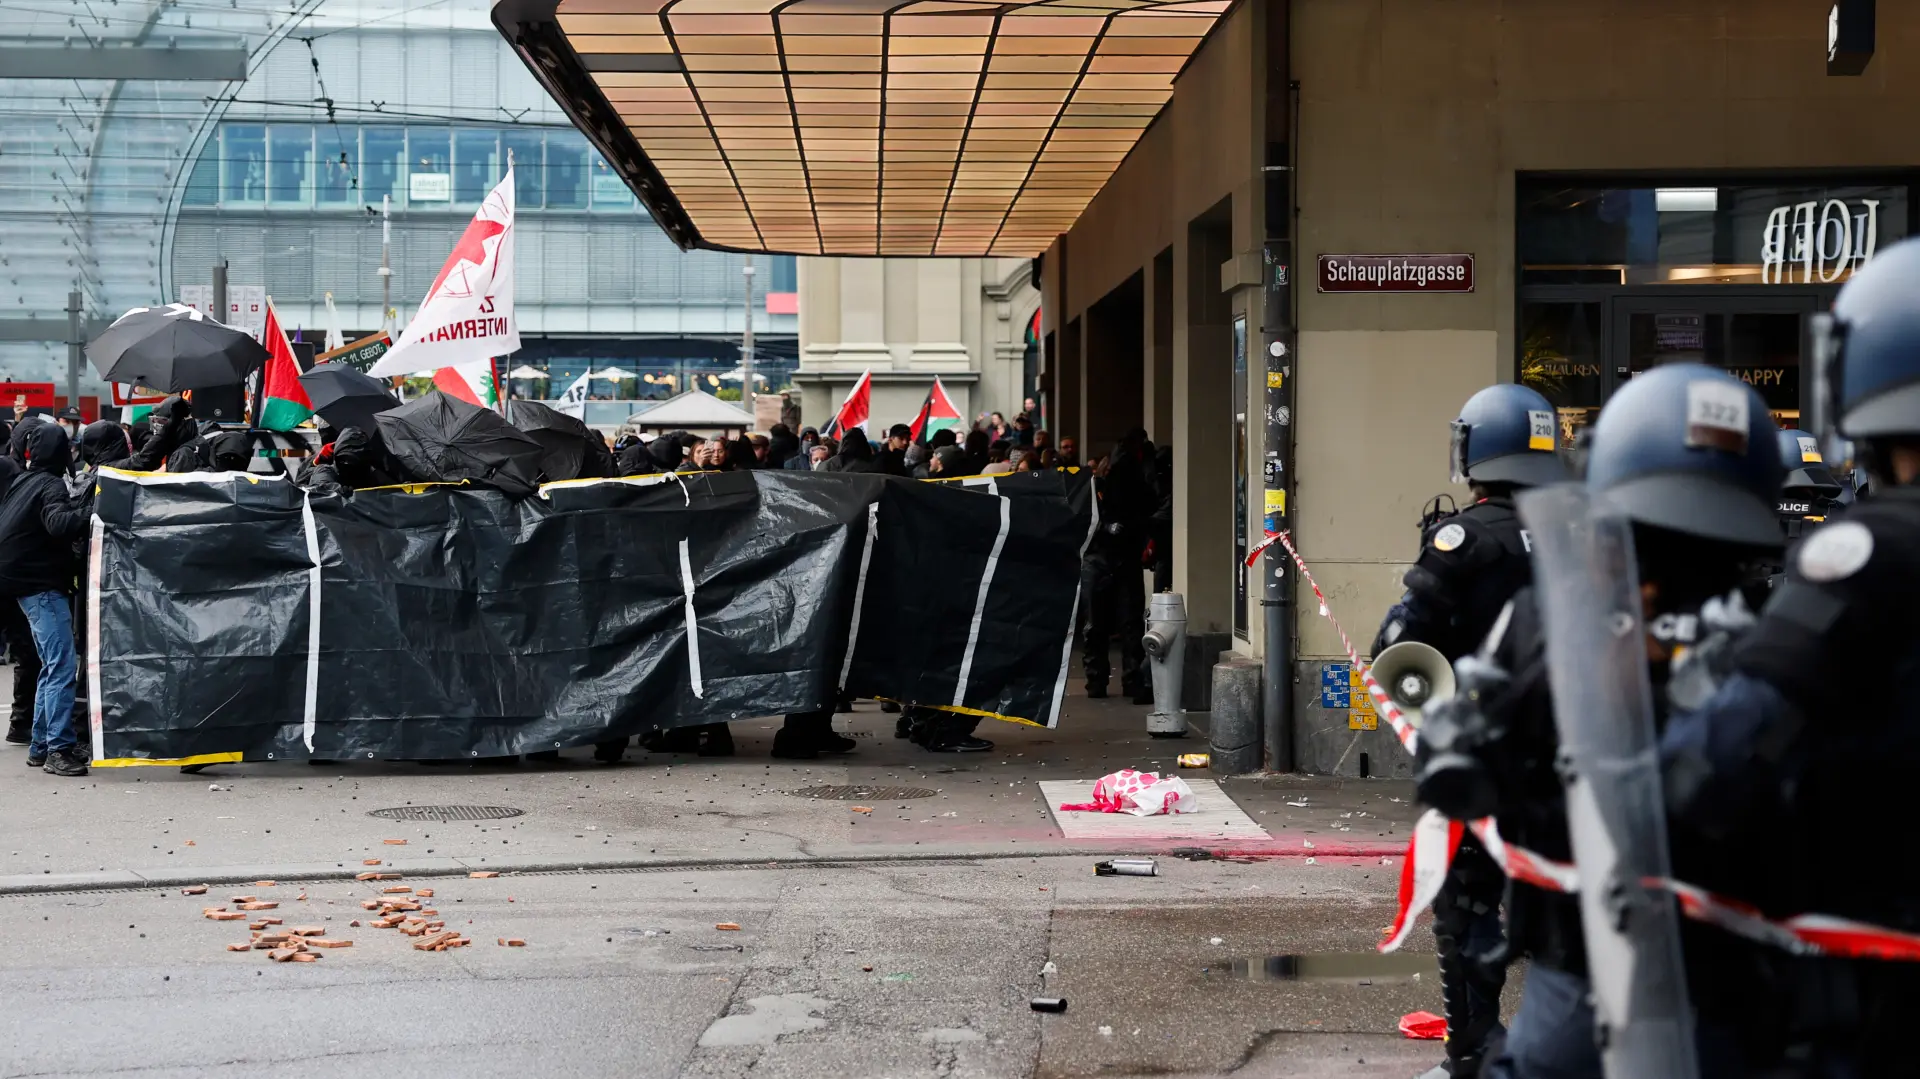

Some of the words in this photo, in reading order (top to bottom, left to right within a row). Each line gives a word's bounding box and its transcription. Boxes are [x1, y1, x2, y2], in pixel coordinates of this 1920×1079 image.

[1327, 260, 1465, 287] Schauplatzgasse
[360, 343, 384, 360] GEBOT:
[1728, 369, 1784, 385] HAPPY
[1535, 424, 1552, 435] 210
